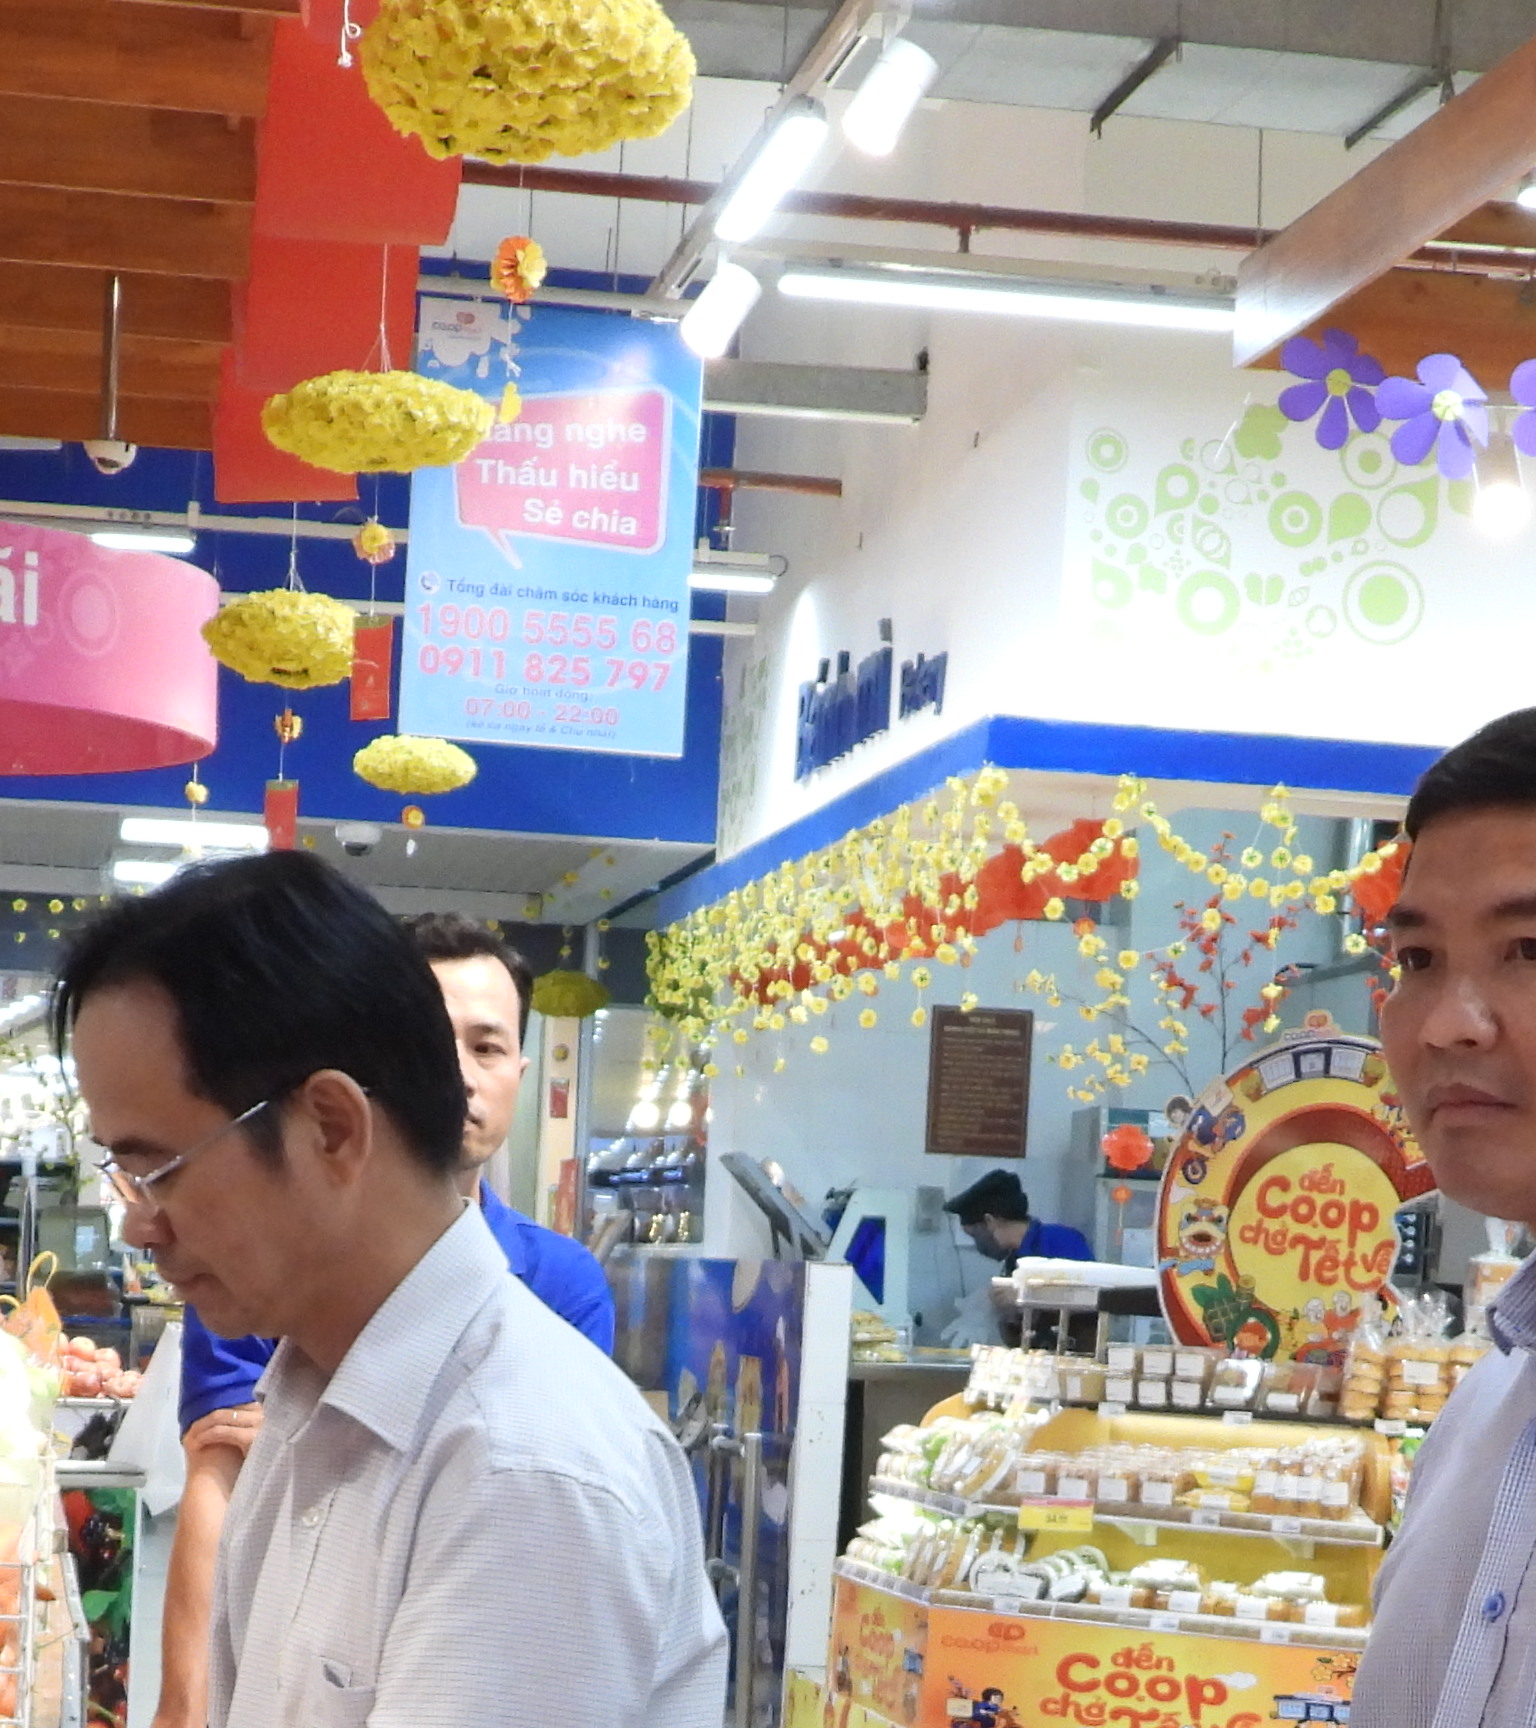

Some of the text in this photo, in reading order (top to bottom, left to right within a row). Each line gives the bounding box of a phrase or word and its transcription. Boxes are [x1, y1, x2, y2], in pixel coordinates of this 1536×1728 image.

[564, 419, 648, 449] nghe
[475, 456, 641, 492] Thấu hiểu
[572, 507, 638, 537] chia
[417, 602, 678, 655] 1900 5555 68
[418, 643, 672, 692] 0911 825 797
[1298, 1161, 1347, 1196] đến
[1288, 1231, 1387, 1293] Tết
[1109, 1640, 1176, 1673] đến
